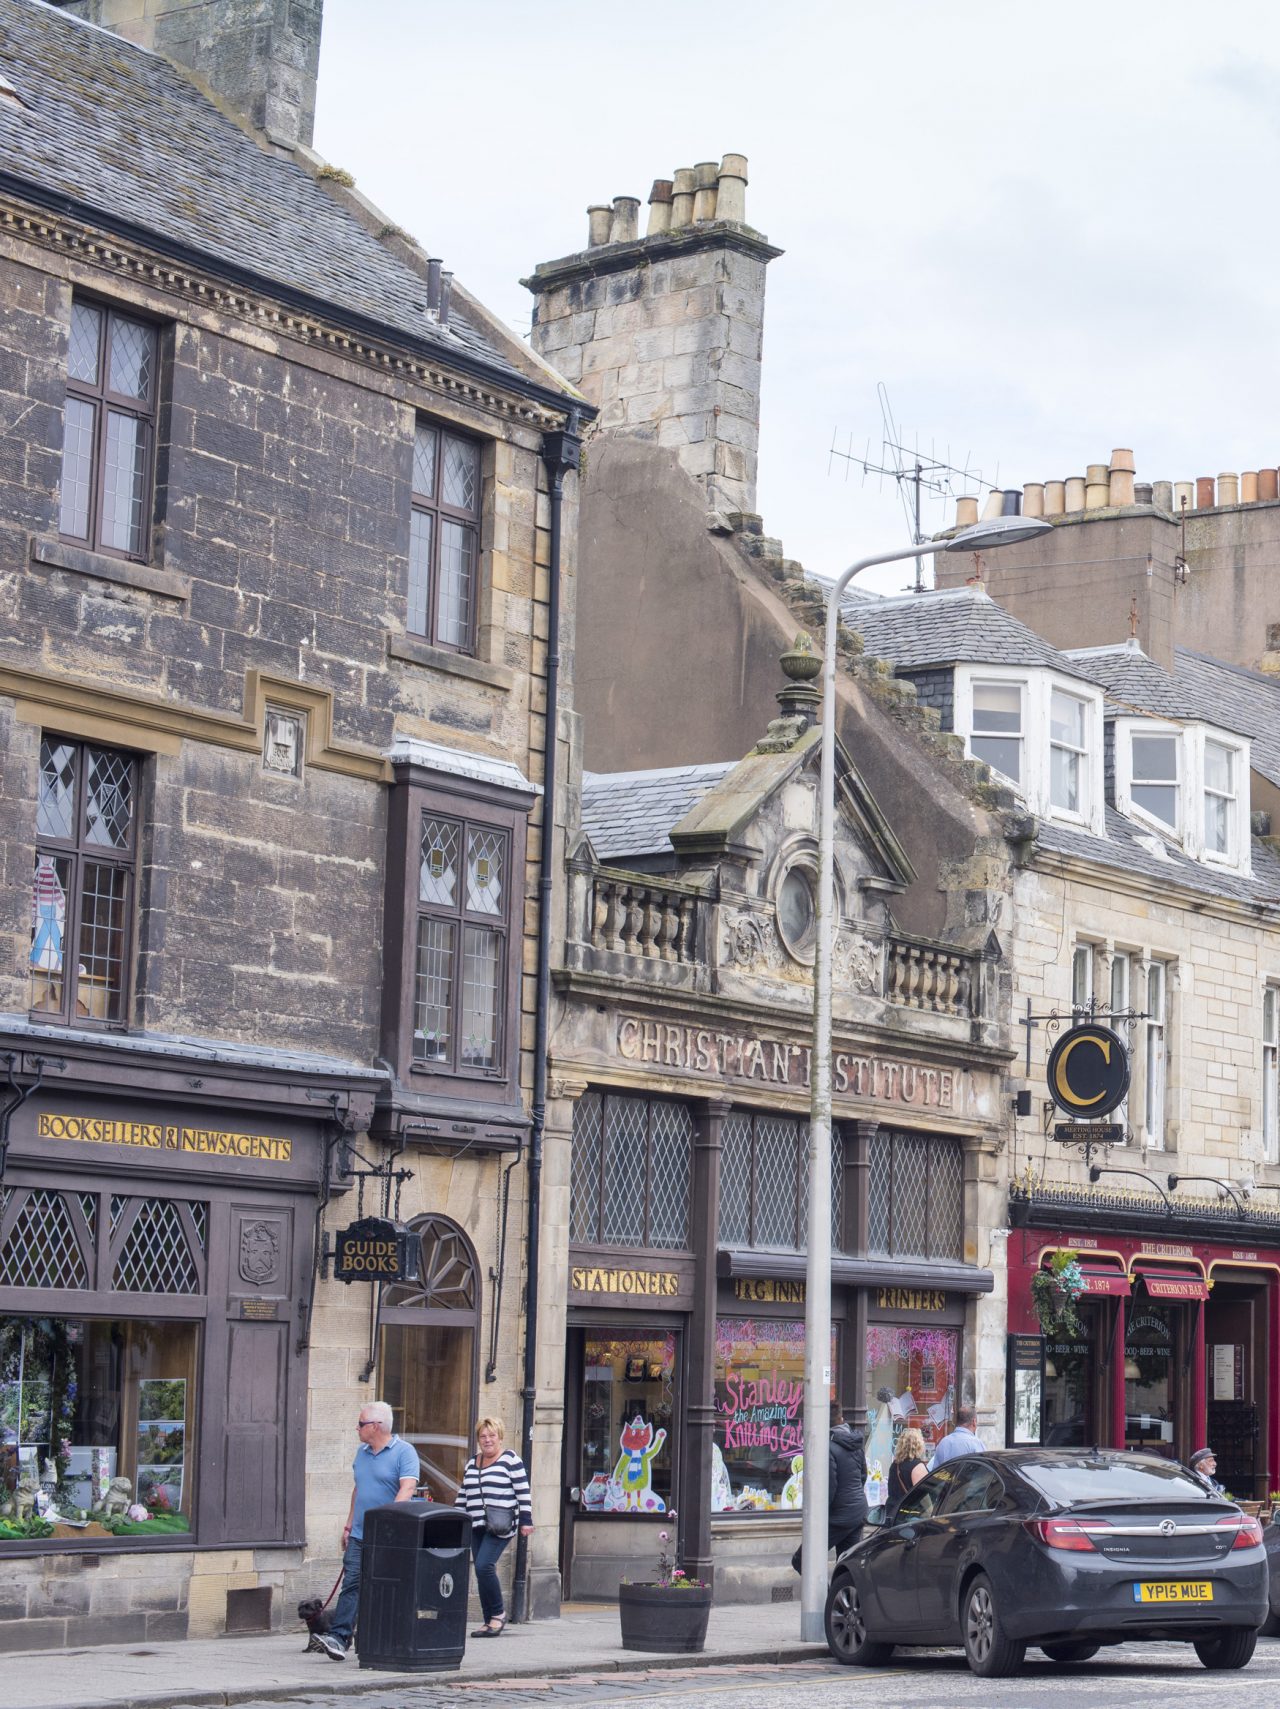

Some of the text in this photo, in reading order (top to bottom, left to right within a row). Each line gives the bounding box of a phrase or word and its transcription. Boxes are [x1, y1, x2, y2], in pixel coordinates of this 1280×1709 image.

[618, 1019, 953, 1108] CHRISTIAN ISTITUTE
[1056, 1036, 1110, 1106] C
[40, 1115, 291, 1160] BOOKSELLERS & NEWSAGENTS
[344, 1241, 398, 1255] GUIDE
[1141, 1243, 1193, 1257] THE CRITERION
[342, 1256, 399, 1272] BOOKS
[572, 1268, 679, 1295] STATIONERS
[772, 1280, 806, 1303] INN
[1095, 1280, 1110, 1291] 1874
[1151, 1283, 1203, 1296] CRITERION BAR
[878, 1288, 946, 1311] PRINTERS
[1135, 1315, 1170, 1340] CRITERION
[1124, 1347, 1171, 1356] OOD BEER WINE
[723, 1369, 803, 1418] Stanley
[734, 1404, 788, 1427] the Amazing
[725, 1420, 778, 1452] Knitting
[1146, 1584, 1208, 1599] YP15 MUE
